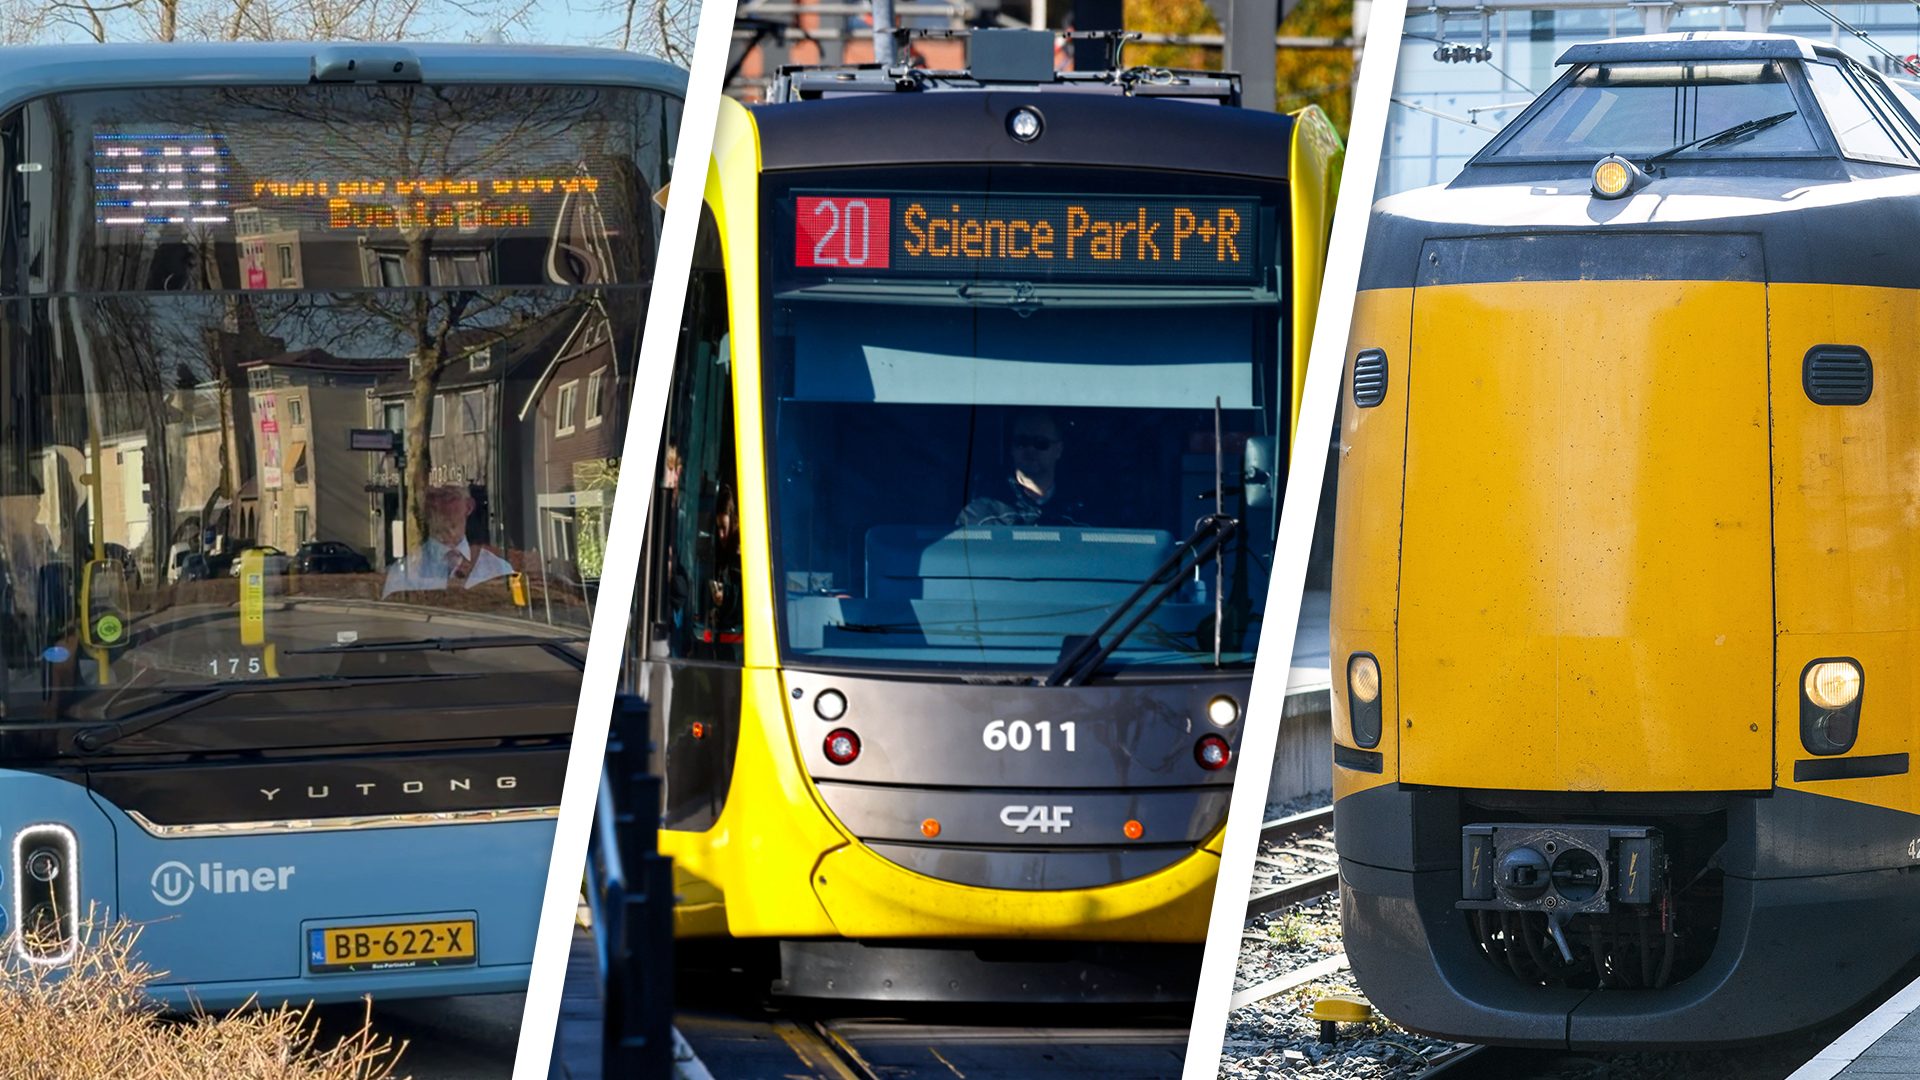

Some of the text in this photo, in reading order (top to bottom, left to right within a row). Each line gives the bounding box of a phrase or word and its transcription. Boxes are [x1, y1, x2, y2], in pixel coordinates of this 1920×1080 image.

[813, 200, 870, 266] 20
[904, 203, 1241, 262] Science Park P+R
[210, 657, 260, 675] 175
[983, 719, 1076, 752] 6011
[260, 776, 518, 801] YUTONG
[1000, 805, 1074, 833] CAF
[312, 951, 324, 960] NL
[335, 927, 462, 959] BB-622-X
